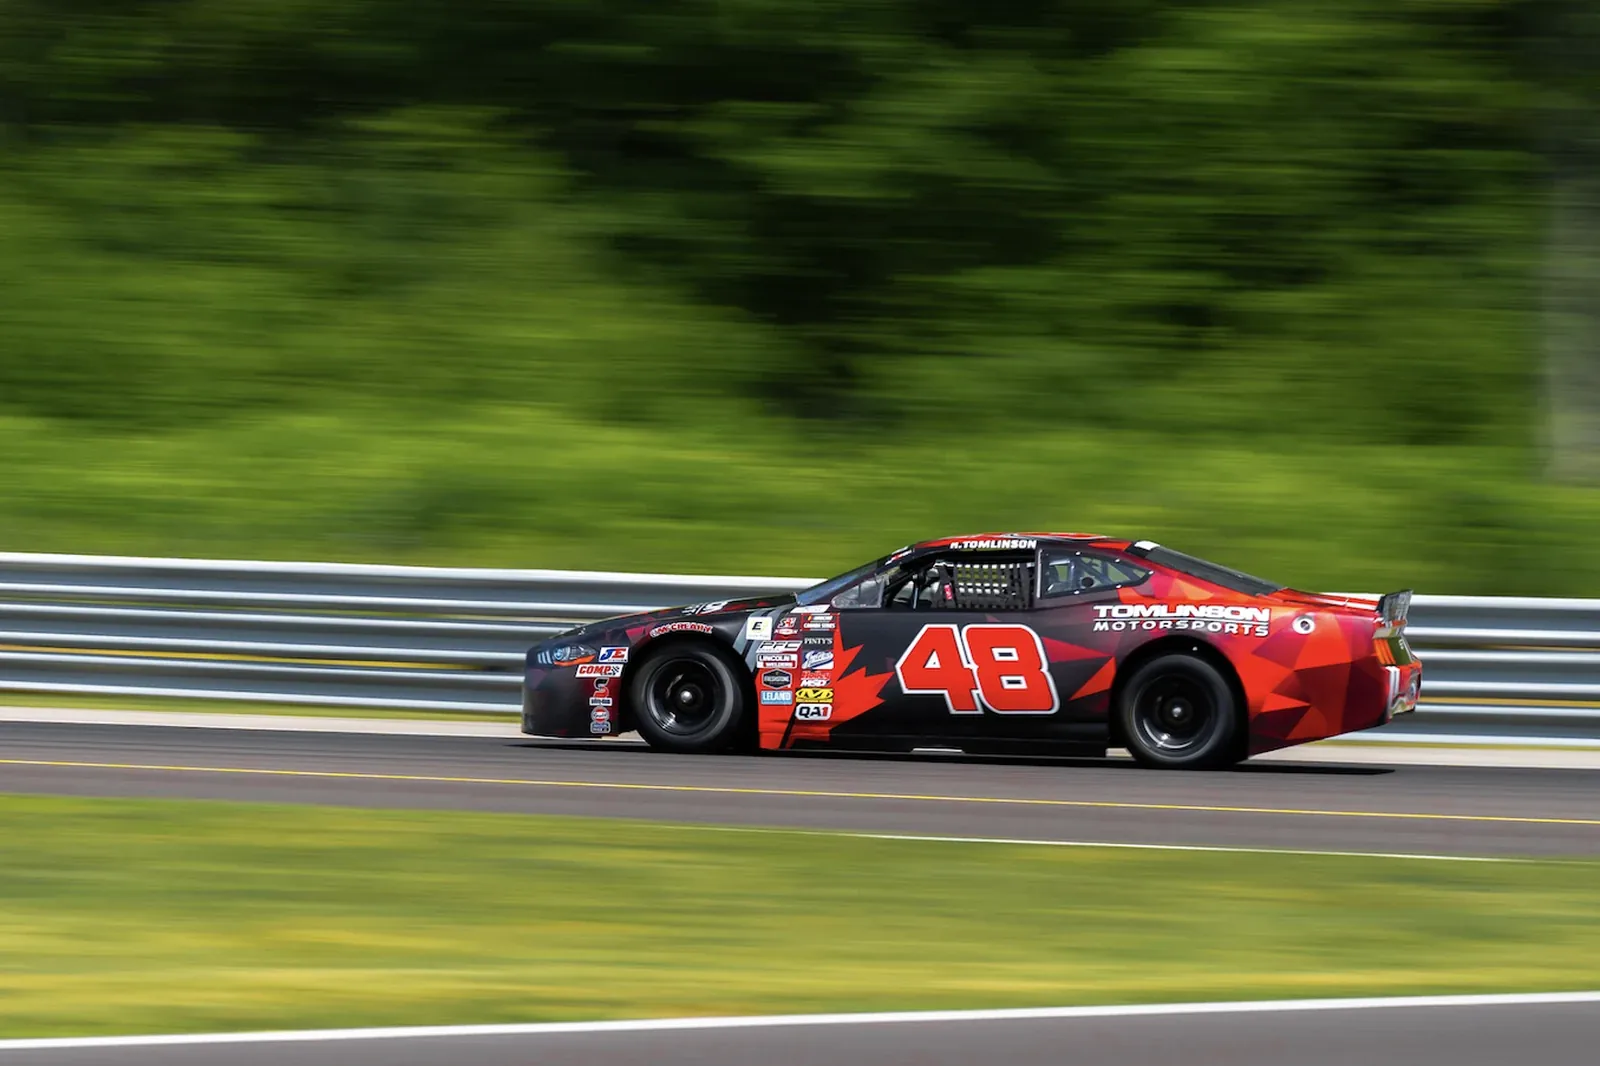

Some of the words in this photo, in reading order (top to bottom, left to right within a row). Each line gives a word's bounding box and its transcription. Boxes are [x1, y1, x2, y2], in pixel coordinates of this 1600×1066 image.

[1093, 604, 1270, 621] TOMLINSON
[1093, 620, 1270, 637] MOTORSPORTS
[580, 666, 612, 675] COMP
[895, 624, 1060, 714] 48
[799, 706, 829, 718] QA1
